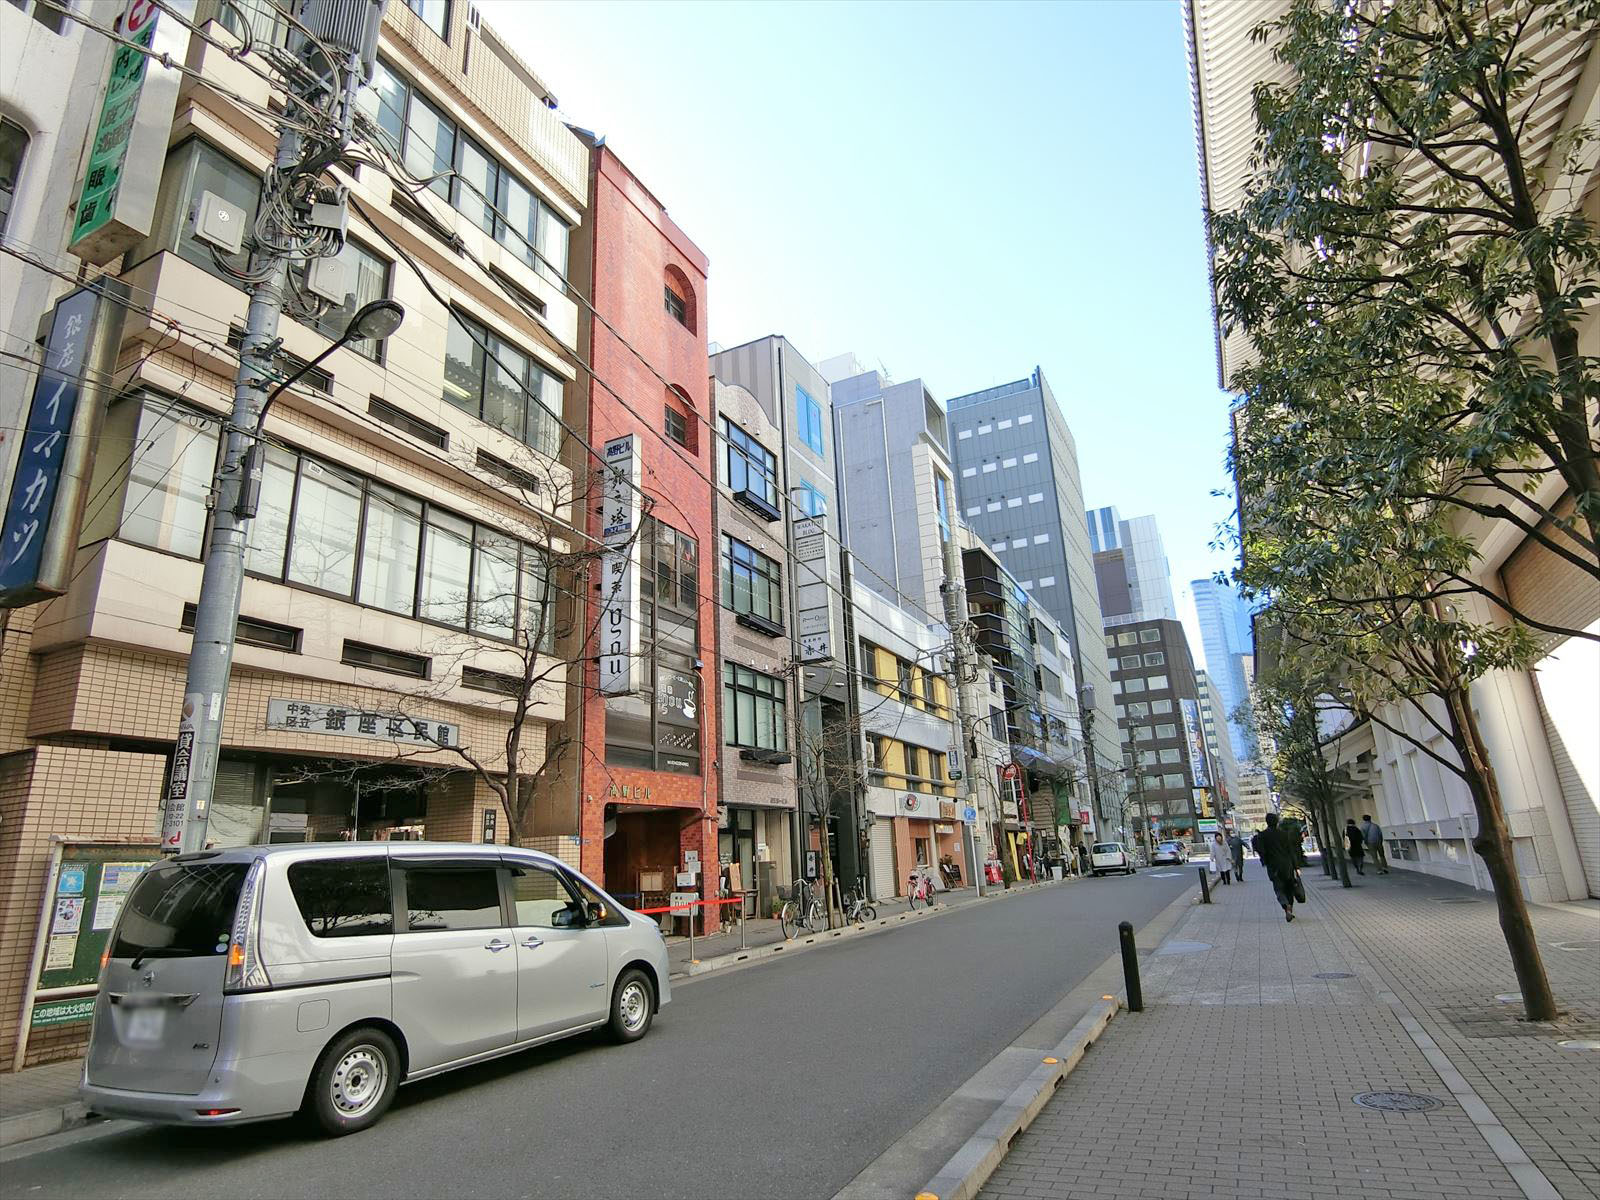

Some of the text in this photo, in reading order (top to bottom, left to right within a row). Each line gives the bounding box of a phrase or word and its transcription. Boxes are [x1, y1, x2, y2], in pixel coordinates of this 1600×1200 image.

[611, 562, 623, 593] 喫茶
[287, 703, 311, 716] 中央
[285, 716, 310, 729] 区立
[325, 708, 450, 746] 銀座区民館
[172, 732, 193, 798] 貸会議室
[609, 784, 651, 800] 高野ビル
